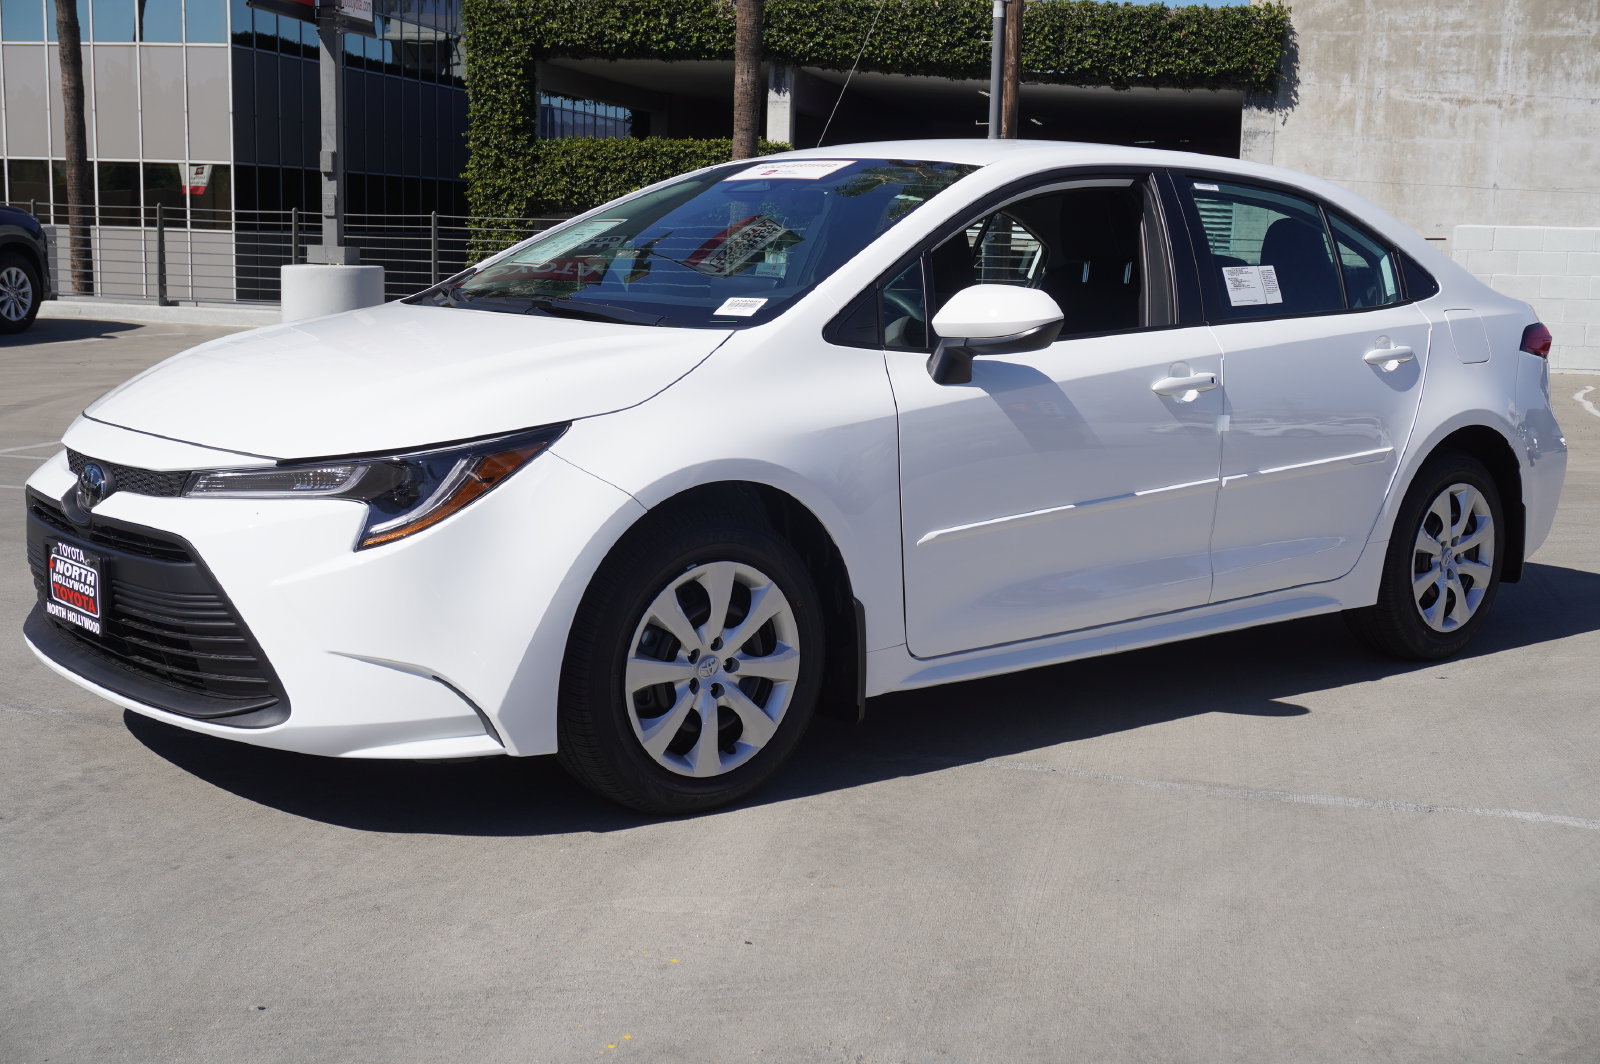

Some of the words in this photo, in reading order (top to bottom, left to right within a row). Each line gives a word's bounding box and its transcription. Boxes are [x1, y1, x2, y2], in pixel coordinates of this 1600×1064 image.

[58, 542, 85, 563] TOYOTA
[53, 572, 94, 597] HOLLYWOOD
[56, 559, 95, 586] NORTH
[53, 583, 96, 614] TOYOTA
[46, 601, 66, 619] NORTH
[67, 609, 100, 635] HOLLYWOOD
